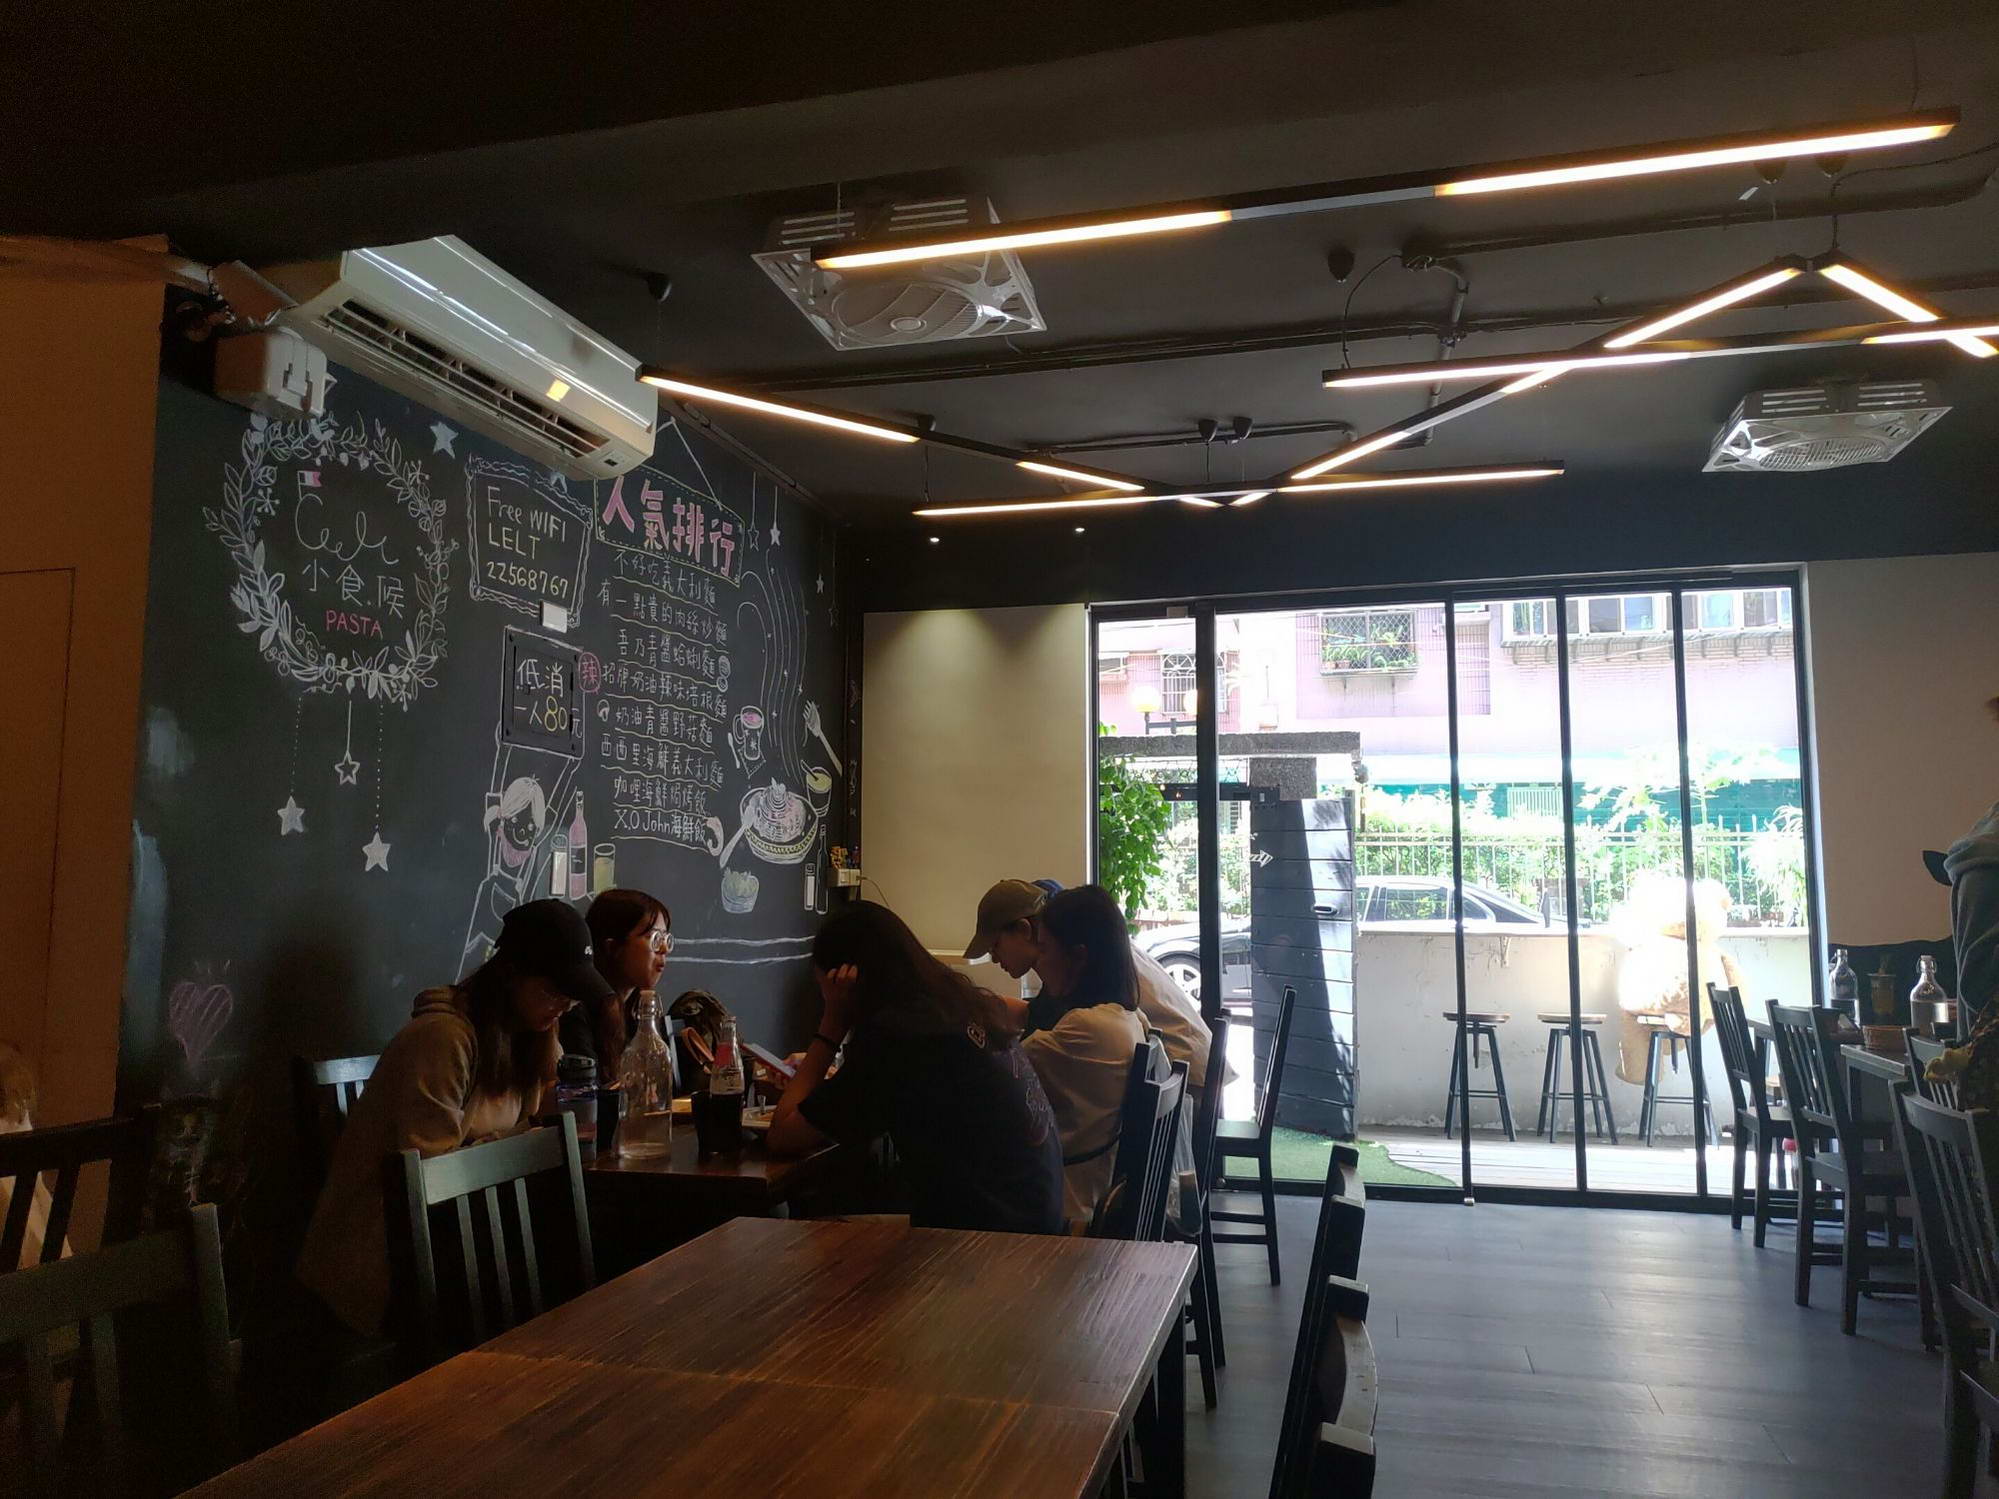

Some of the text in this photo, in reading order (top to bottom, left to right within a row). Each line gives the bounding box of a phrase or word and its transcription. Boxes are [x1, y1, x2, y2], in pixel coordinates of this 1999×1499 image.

[487, 485, 567, 543] Free WIFI
[601, 475, 736, 577] 人氣排行
[488, 522, 541, 560] LELT
[486, 560, 569, 599] 22568767
[325, 610, 383, 640] PASTA
[516, 658, 564, 698] 低消
